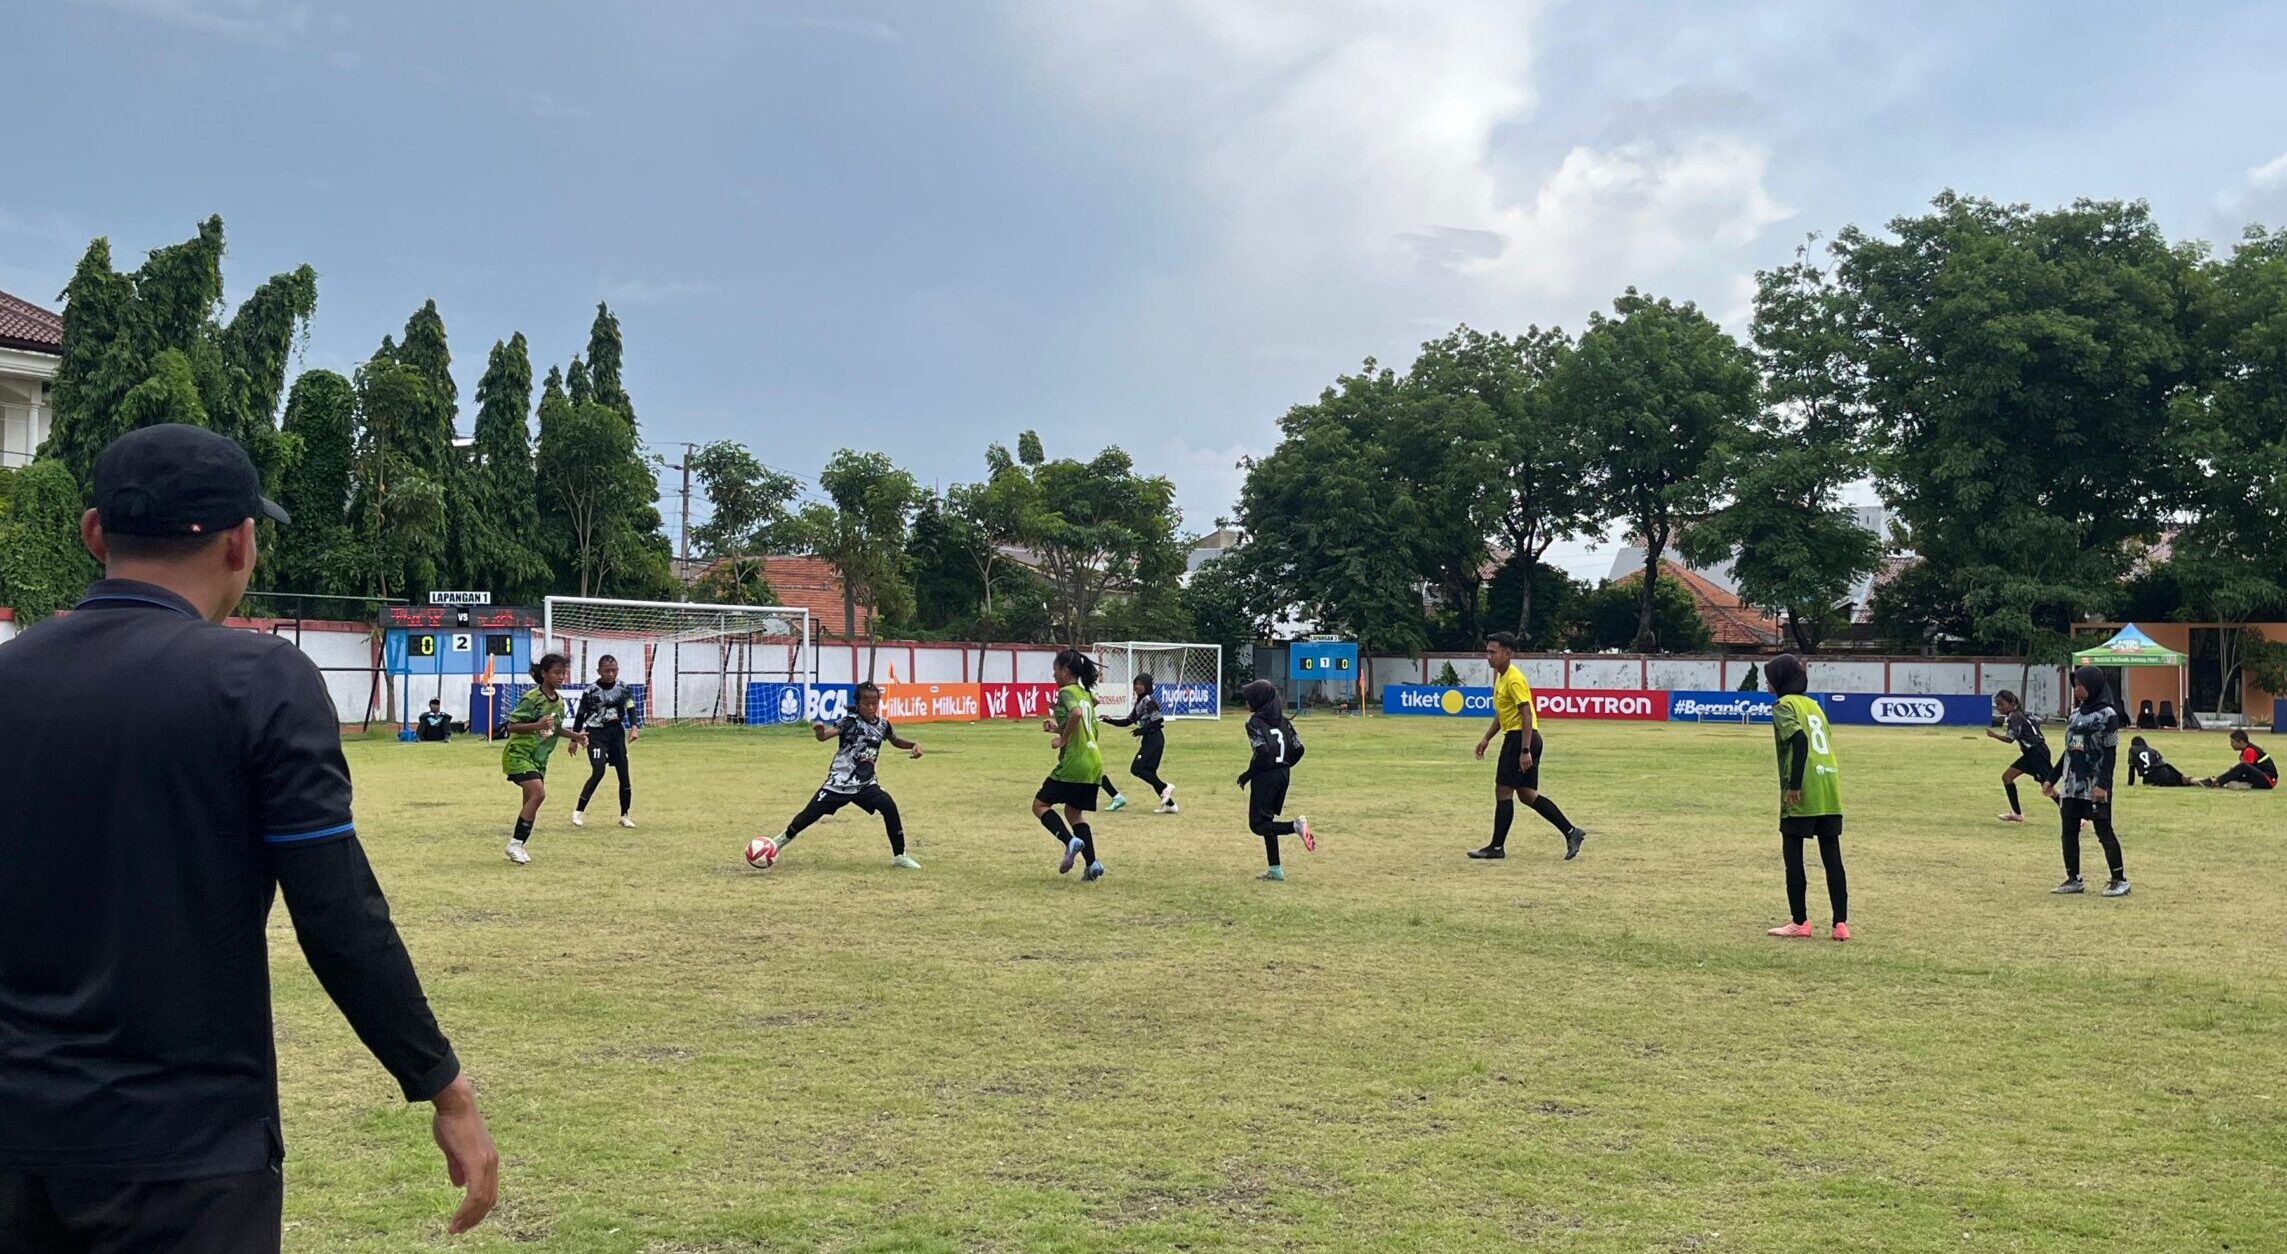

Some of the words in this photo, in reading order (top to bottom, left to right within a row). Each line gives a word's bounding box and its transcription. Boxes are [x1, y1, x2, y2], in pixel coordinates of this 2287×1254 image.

[432, 592, 481, 603] LAPANGAN
[482, 592, 488, 603] 1
[457, 613, 468, 622] VS
[421, 635, 434, 655] 0
[456, 636, 468, 650] 2
[1305, 658, 1312, 670] 0
[1341, 658, 1349, 670] 0
[808, 689, 848, 721] BCA
[932, 695, 977, 716] MilkLife
[985, 685, 1009, 718] Vit
[1016, 685, 1040, 718] Vit
[1161, 685, 1209, 708] hydroplus
[1400, 690, 1440, 708] tiket
[878, 696, 928, 718] MilkLife
[1880, 702, 1937, 719] FOX'S
[1807, 714, 1829, 755] 8
[592, 748, 601, 759] 11
[1269, 728, 1286, 763] 3
[2139, 751, 2150, 768] 9
